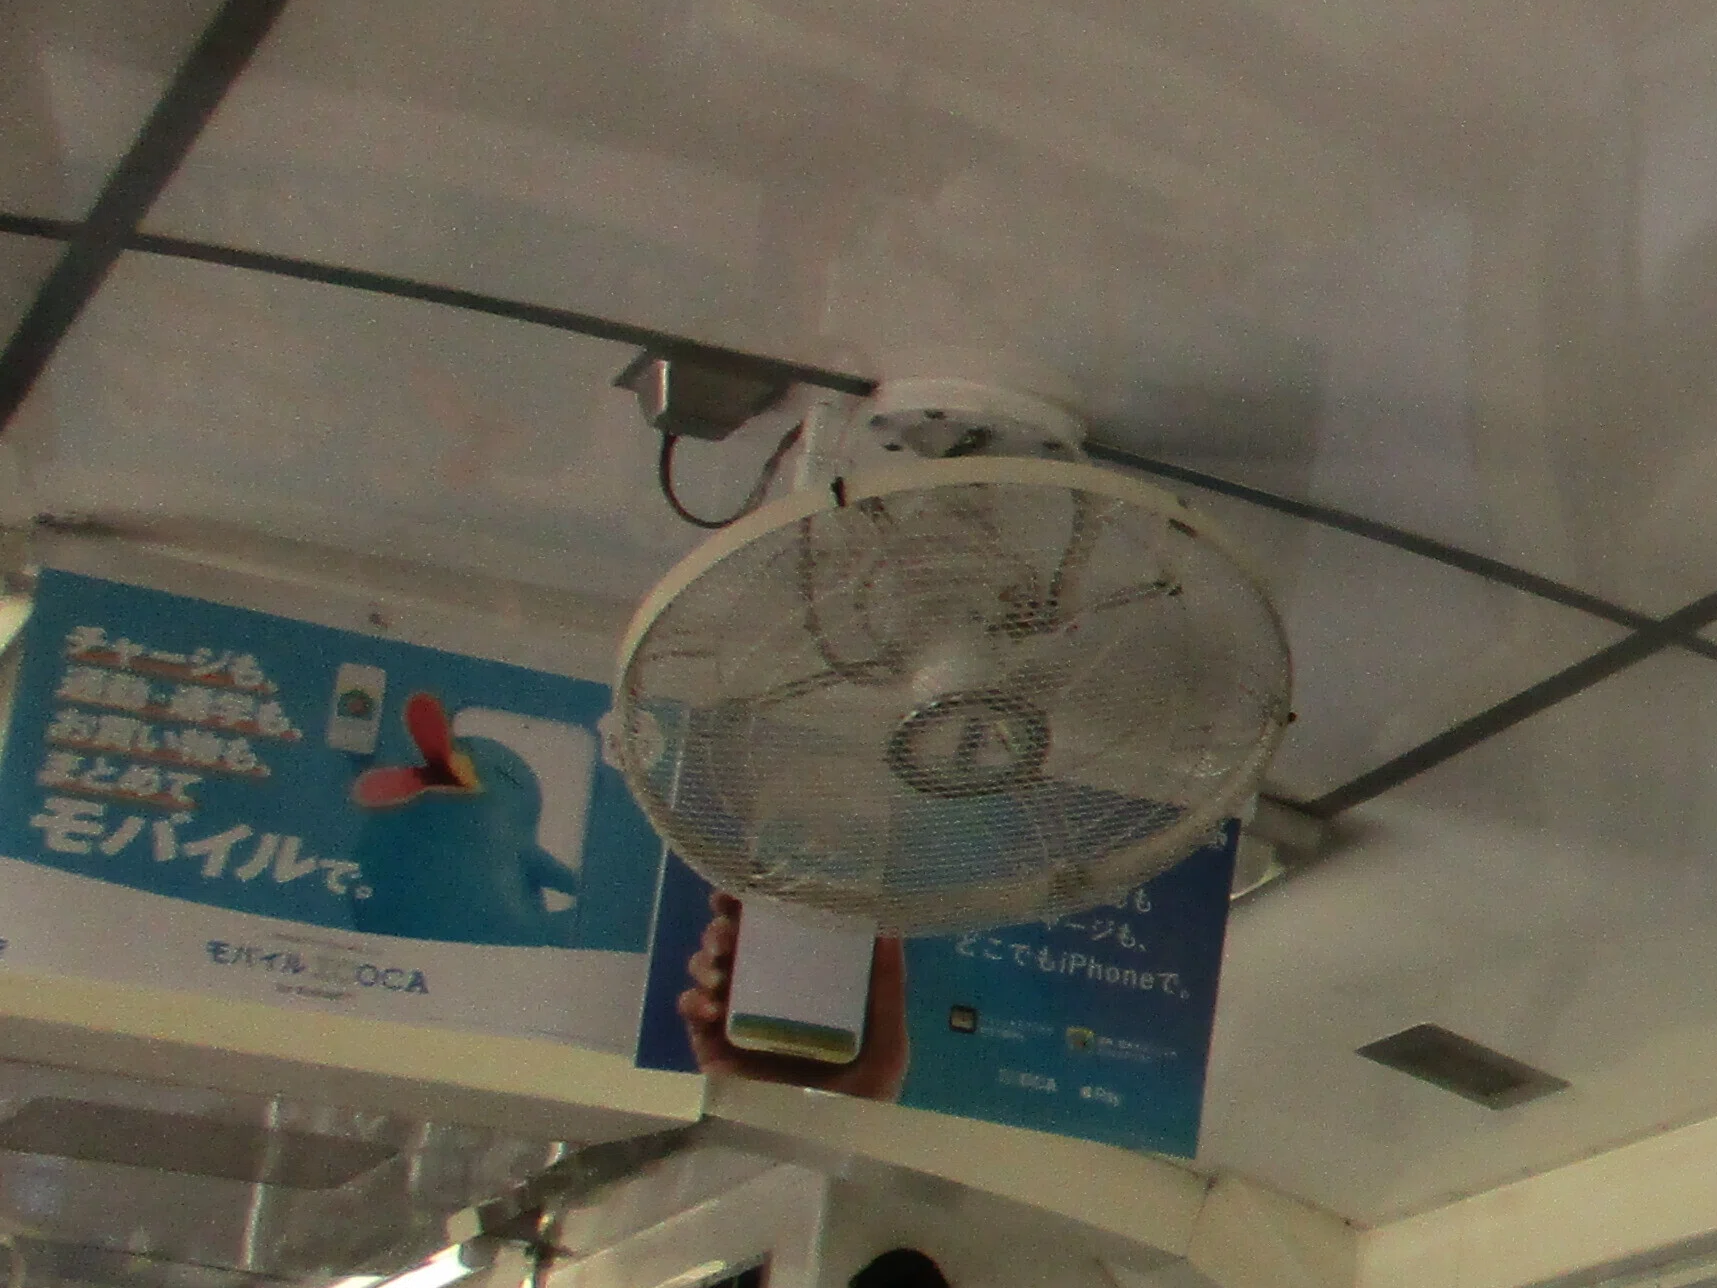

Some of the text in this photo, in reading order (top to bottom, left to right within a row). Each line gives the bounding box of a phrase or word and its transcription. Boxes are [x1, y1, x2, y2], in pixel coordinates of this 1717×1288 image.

[28, 795, 375, 900] モバイルで。
